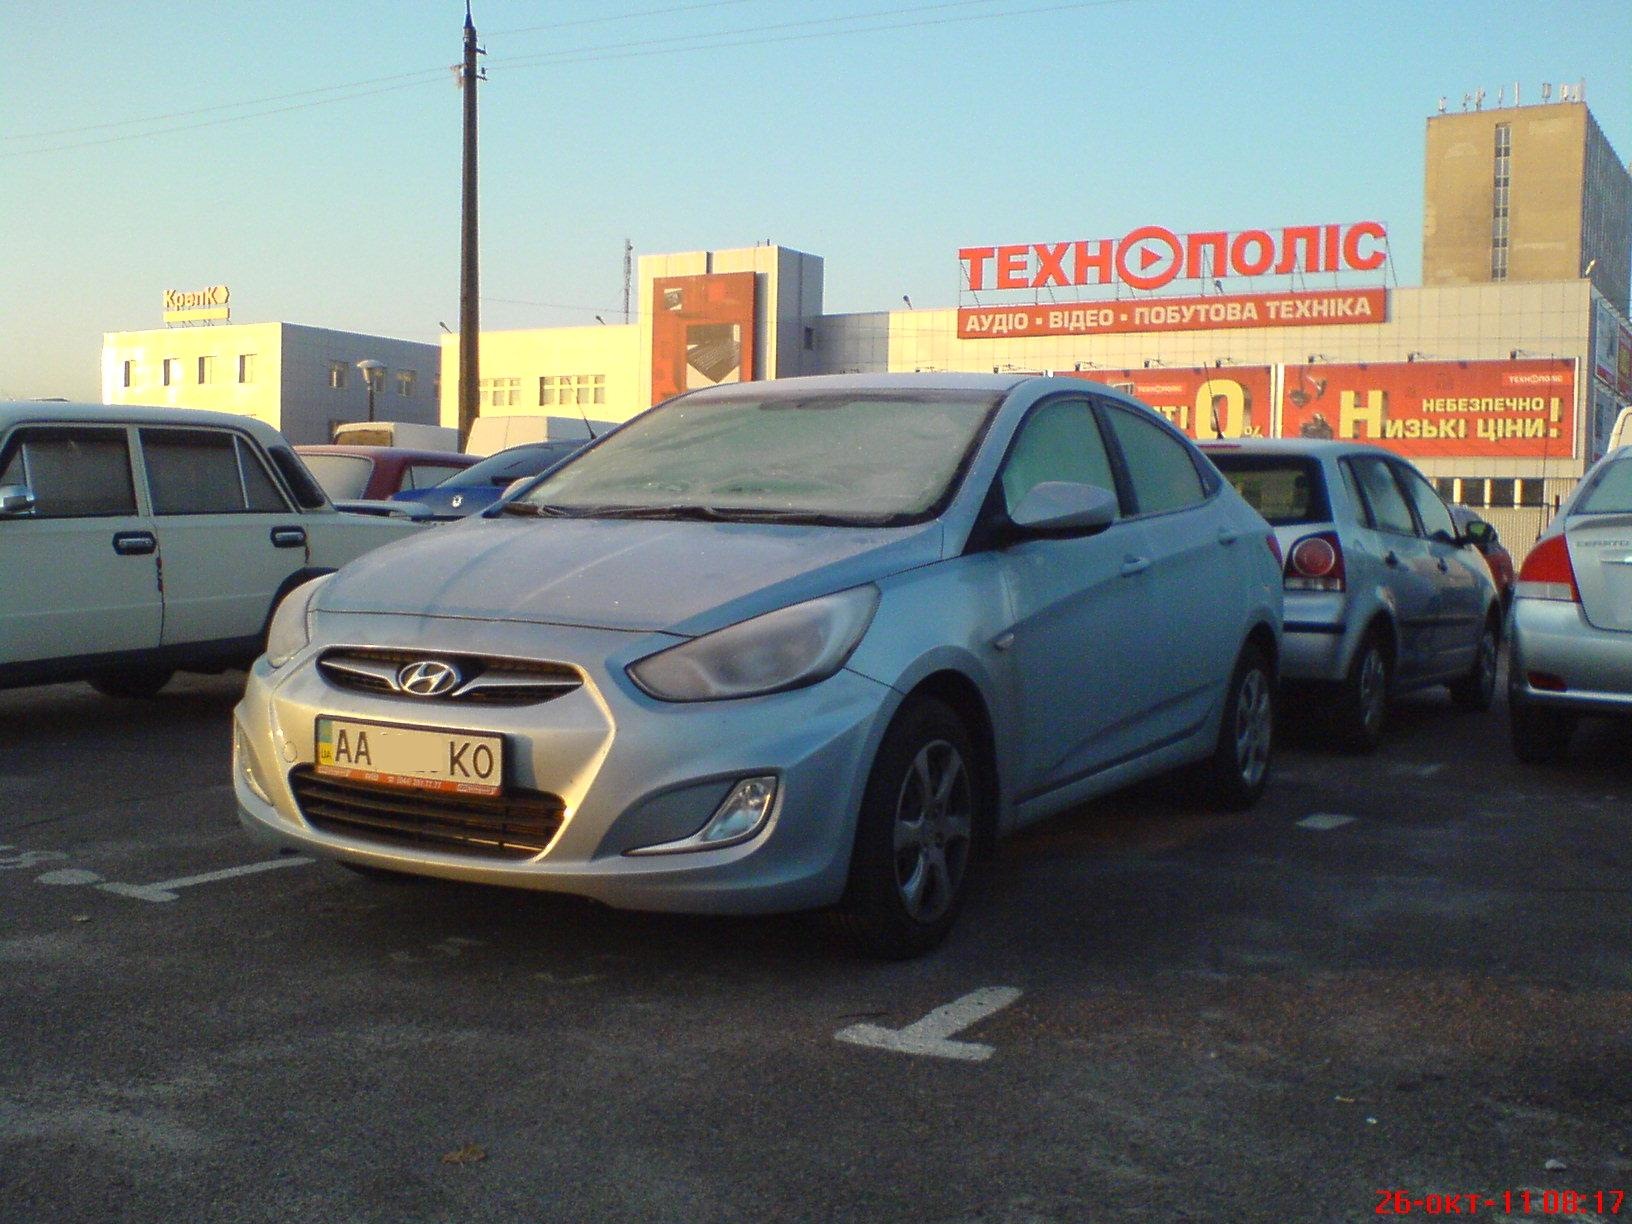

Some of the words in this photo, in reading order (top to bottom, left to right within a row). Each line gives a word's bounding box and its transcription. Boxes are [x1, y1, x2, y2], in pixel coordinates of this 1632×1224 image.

[958, 221, 1388, 291] ТЕХНОПОЛІС
[966, 312, 1029, 334] АУДІО
[1049, 308, 1114, 331] ВІДЕО
[1134, 301, 1258, 325] ПОБУТОВА
[1266, 297, 1371, 320] ТЕХНІКА
[1422, 397, 1545, 413] НЕБЕЗПЕЧНО
[335, 728, 372, 766] AA
[449, 741, 494, 779] KO
